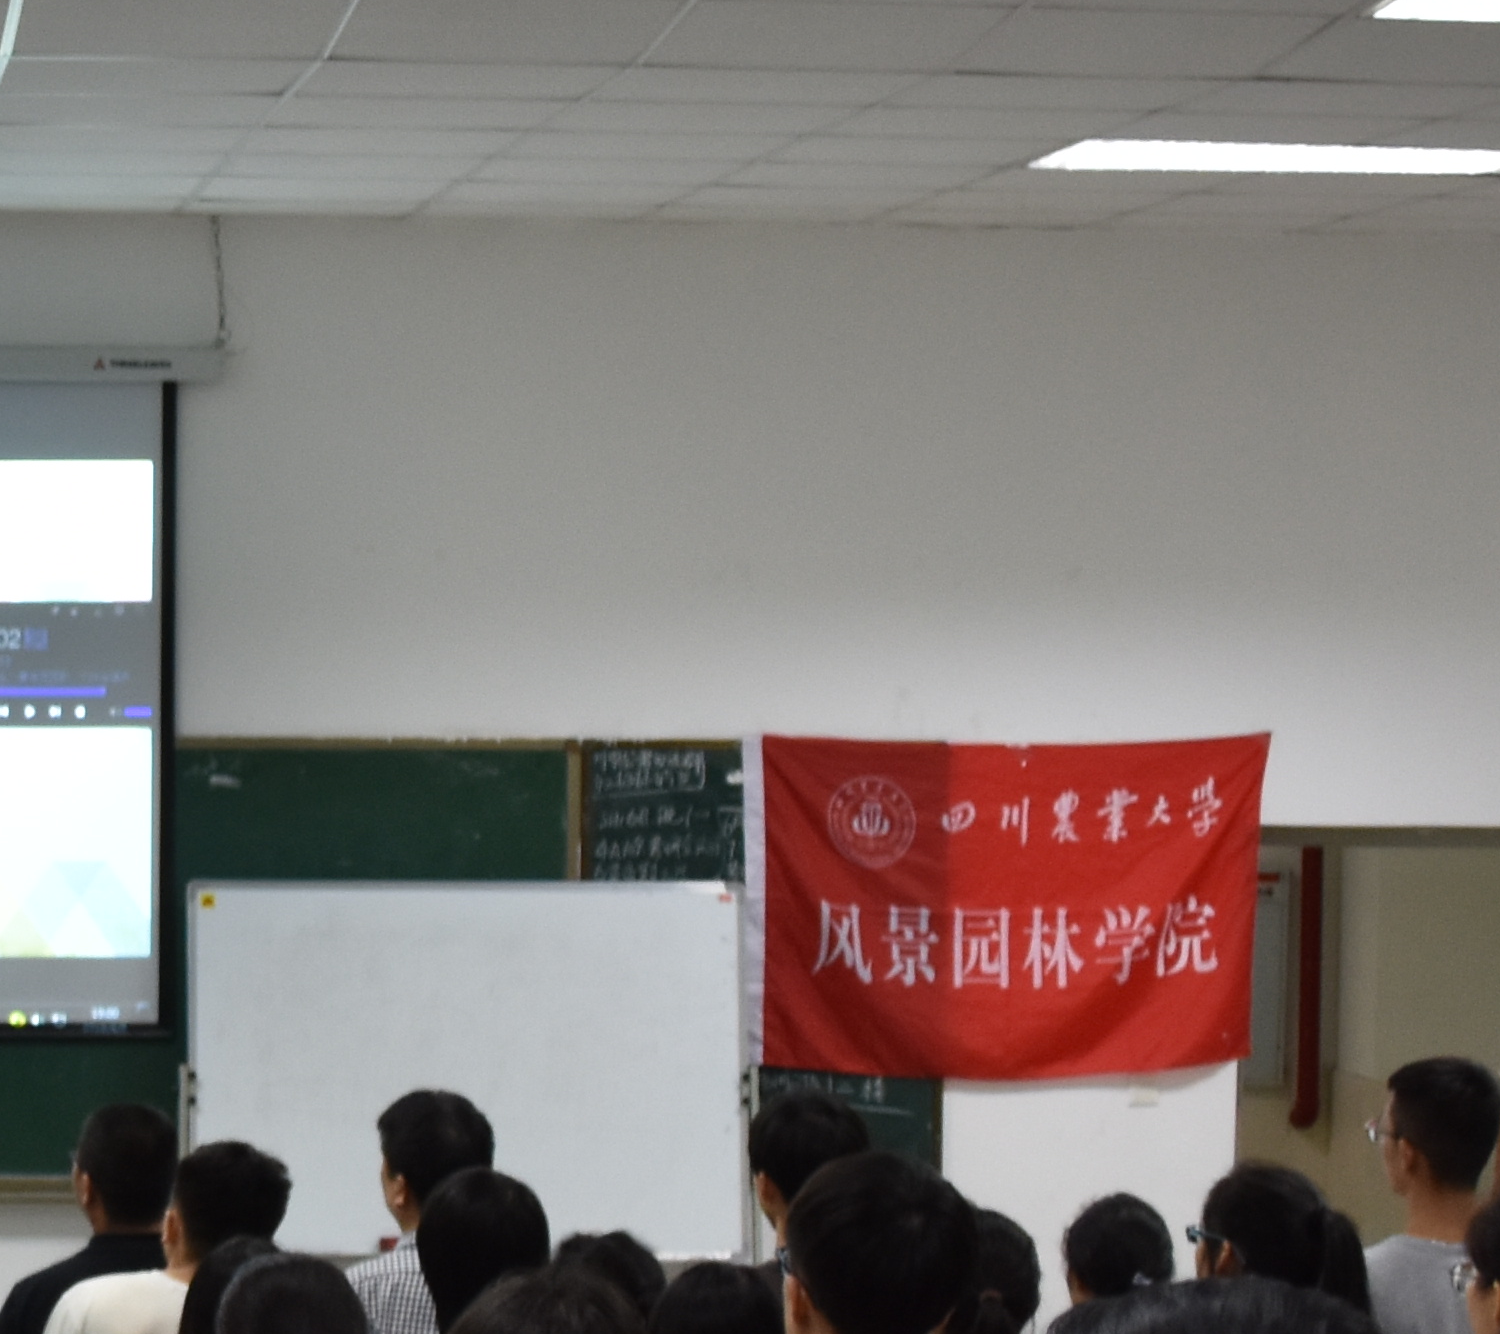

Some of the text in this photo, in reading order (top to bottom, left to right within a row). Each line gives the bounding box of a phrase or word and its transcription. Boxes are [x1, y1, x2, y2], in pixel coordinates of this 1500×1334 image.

[811, 895, 1218, 989] 风景园林学院
